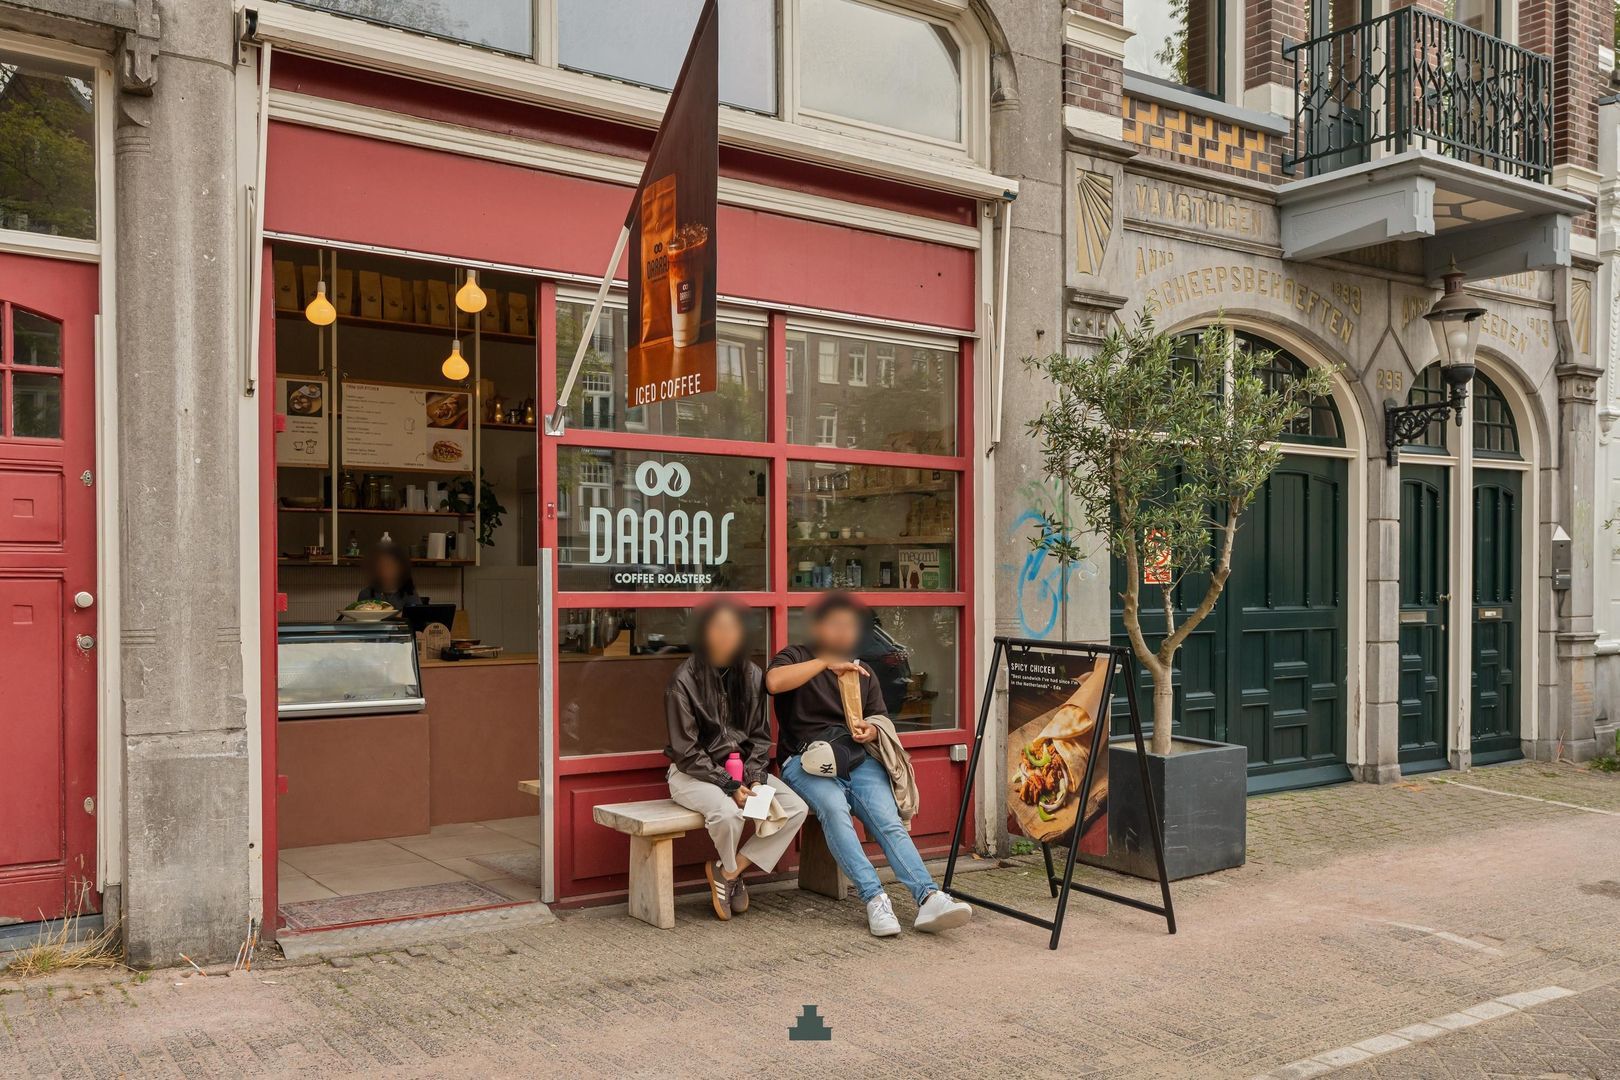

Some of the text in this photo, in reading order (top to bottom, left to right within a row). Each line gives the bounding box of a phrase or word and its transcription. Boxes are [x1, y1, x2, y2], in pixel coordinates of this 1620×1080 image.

[1135, 183, 1262, 238] VAARTUIGEN
[1146, 265, 1354, 345] SCHEEPSBEHOEFTEN
[1331, 280, 1362, 315] 1893
[1480, 311, 1528, 354] EEDEN
[635, 373, 701, 405] ICED COFFEE
[1376, 368, 1403, 392] 295
[589, 507, 735, 566] DARRAS
[615, 573, 712, 584] COFFEE ROASTERS
[1010, 663, 1056, 674] SPICY CHICKEN
[819, 763, 834, 774] NY
